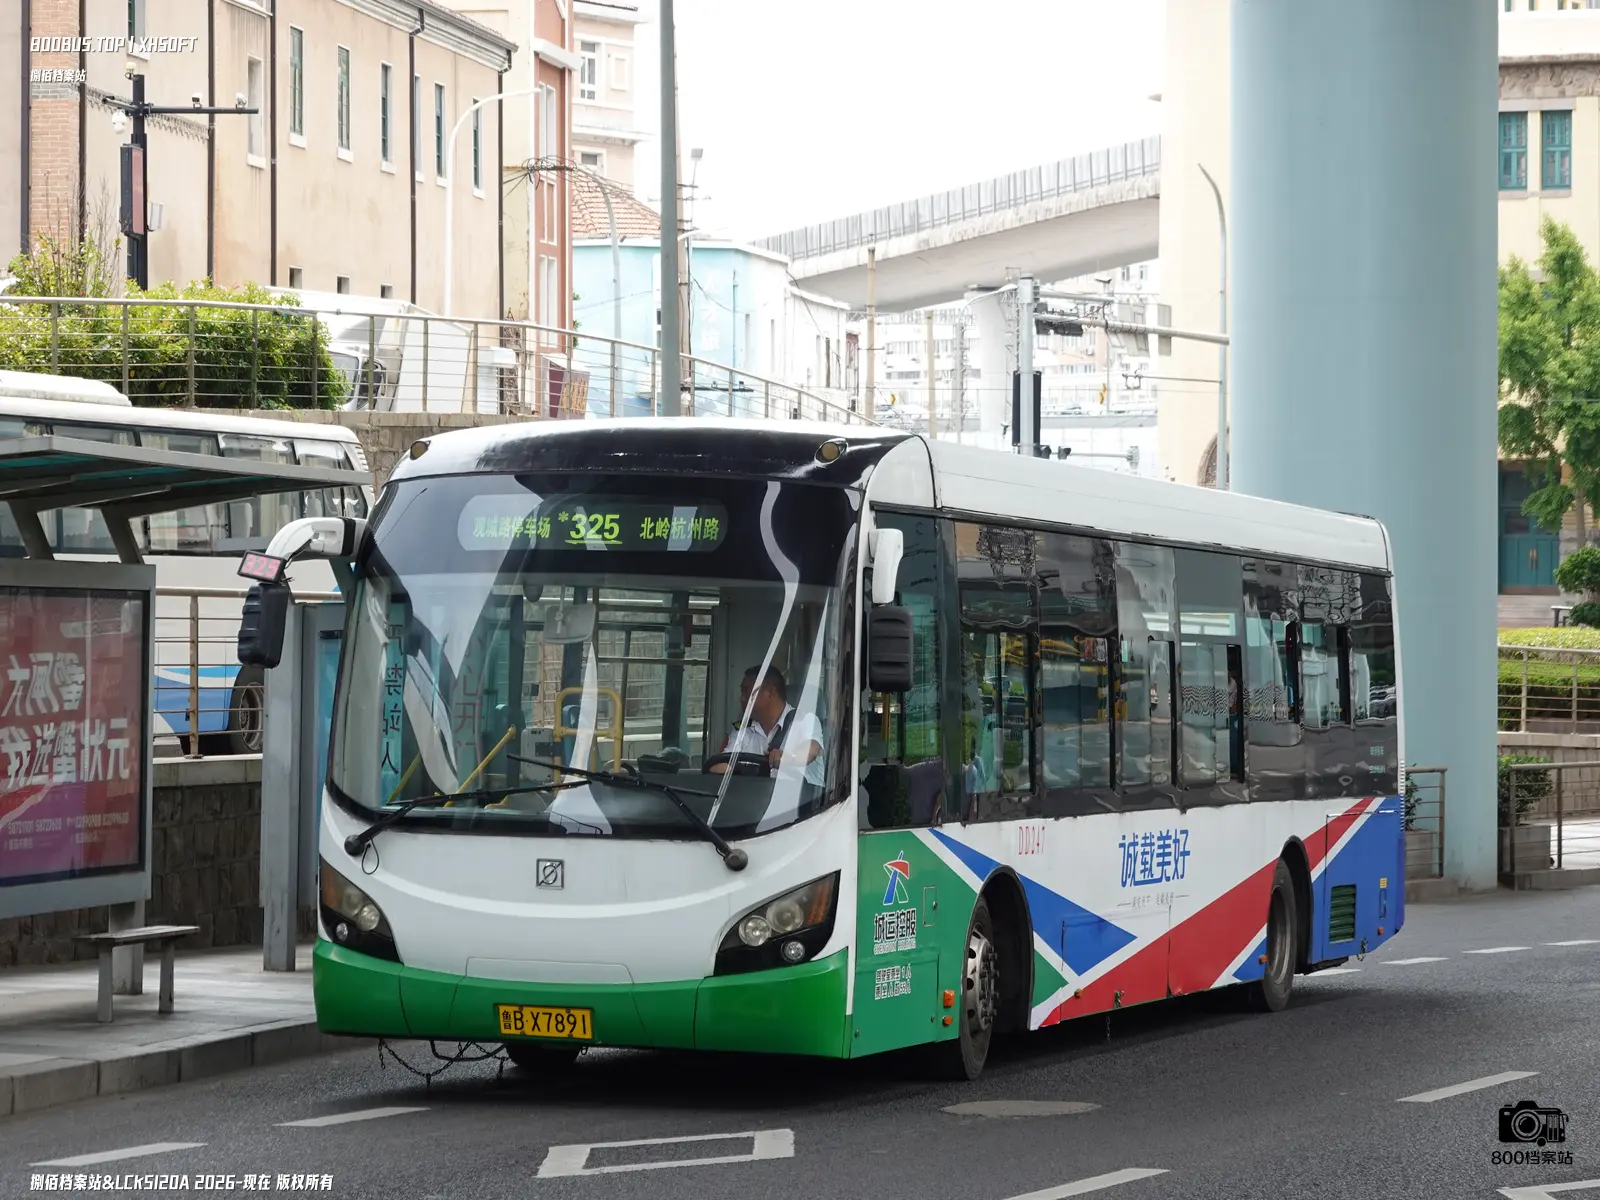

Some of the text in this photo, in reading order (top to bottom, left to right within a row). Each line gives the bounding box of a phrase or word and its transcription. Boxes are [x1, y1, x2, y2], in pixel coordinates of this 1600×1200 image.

[639, 517, 720, 541] 北岭杭州路
[244, 553, 281, 578] 325
[1118, 829, 1191, 888] 诚载美好
[874, 908, 917, 943] 城运控股
